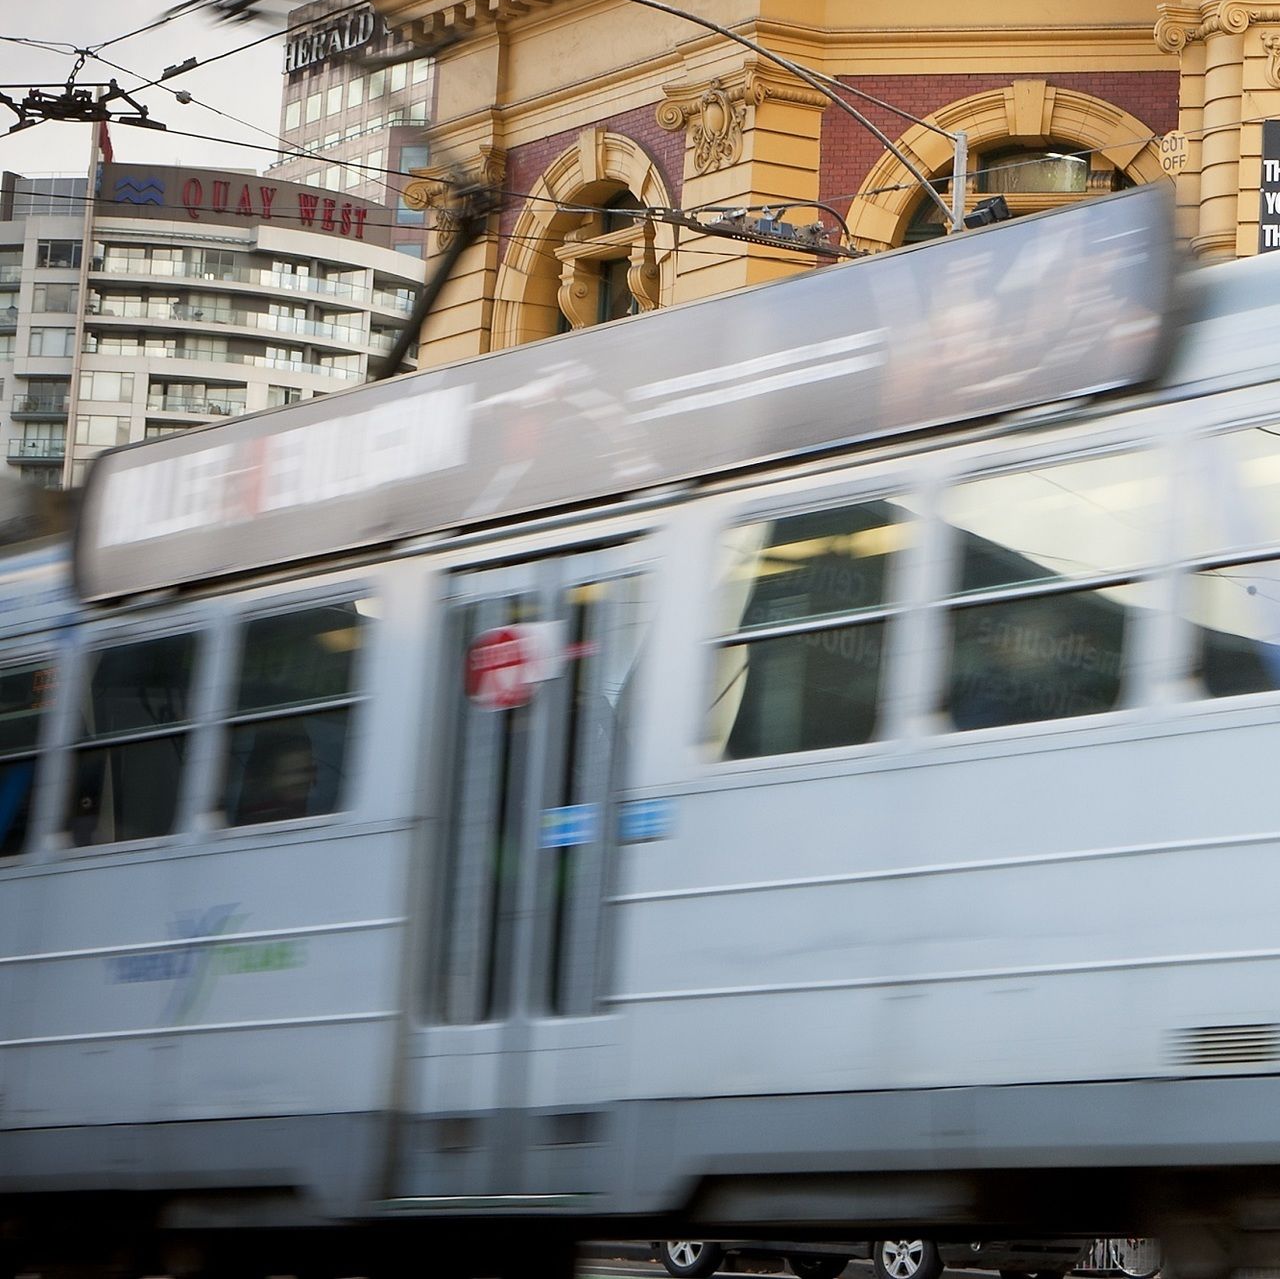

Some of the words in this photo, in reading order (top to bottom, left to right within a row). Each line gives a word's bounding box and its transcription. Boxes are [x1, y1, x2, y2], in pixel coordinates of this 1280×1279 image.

[284, 10, 375, 71] HERALD
[182, 177, 278, 220] QUAY
[298, 192, 368, 239] WEST
